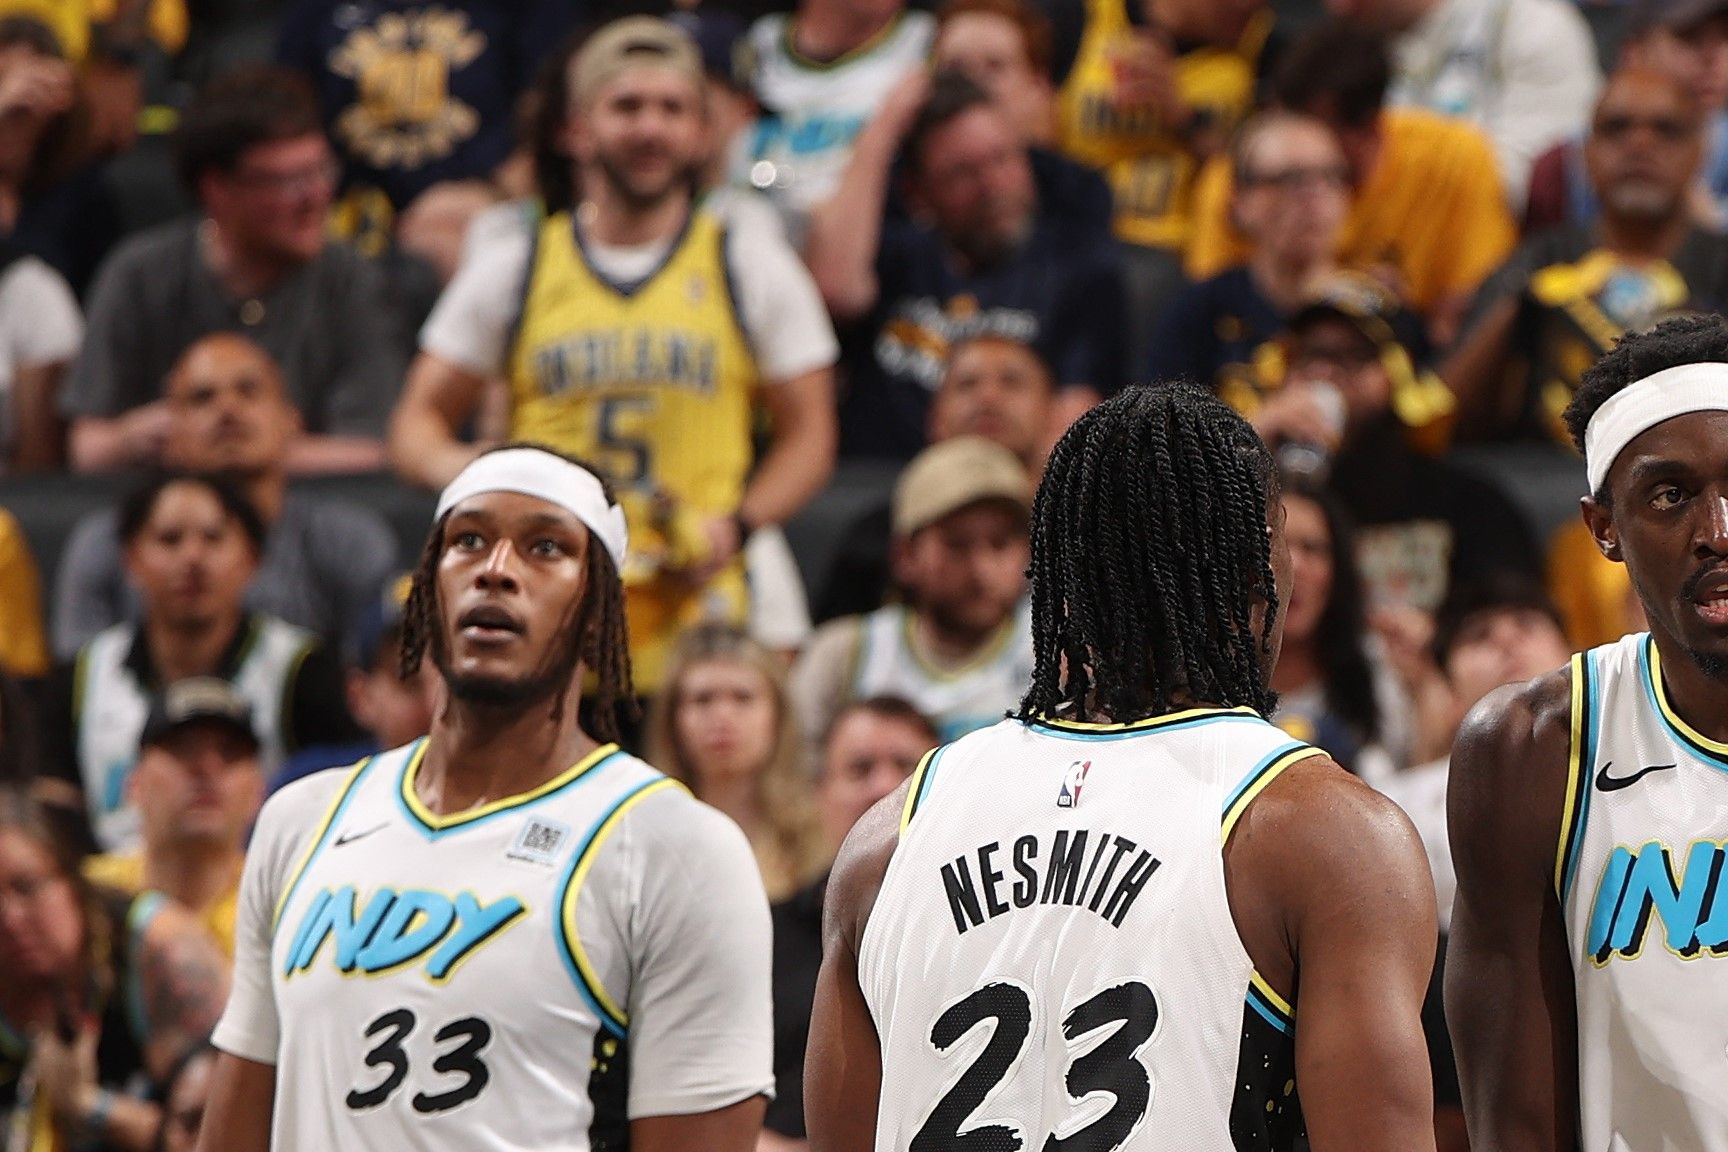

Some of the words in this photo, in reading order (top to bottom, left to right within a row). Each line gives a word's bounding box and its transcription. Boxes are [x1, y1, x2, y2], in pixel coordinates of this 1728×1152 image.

[597, 393, 654, 488] 5
[940, 829, 1161, 934] NESMITH
[283, 884, 527, 984] INDY
[346, 1009, 491, 1114] 33
